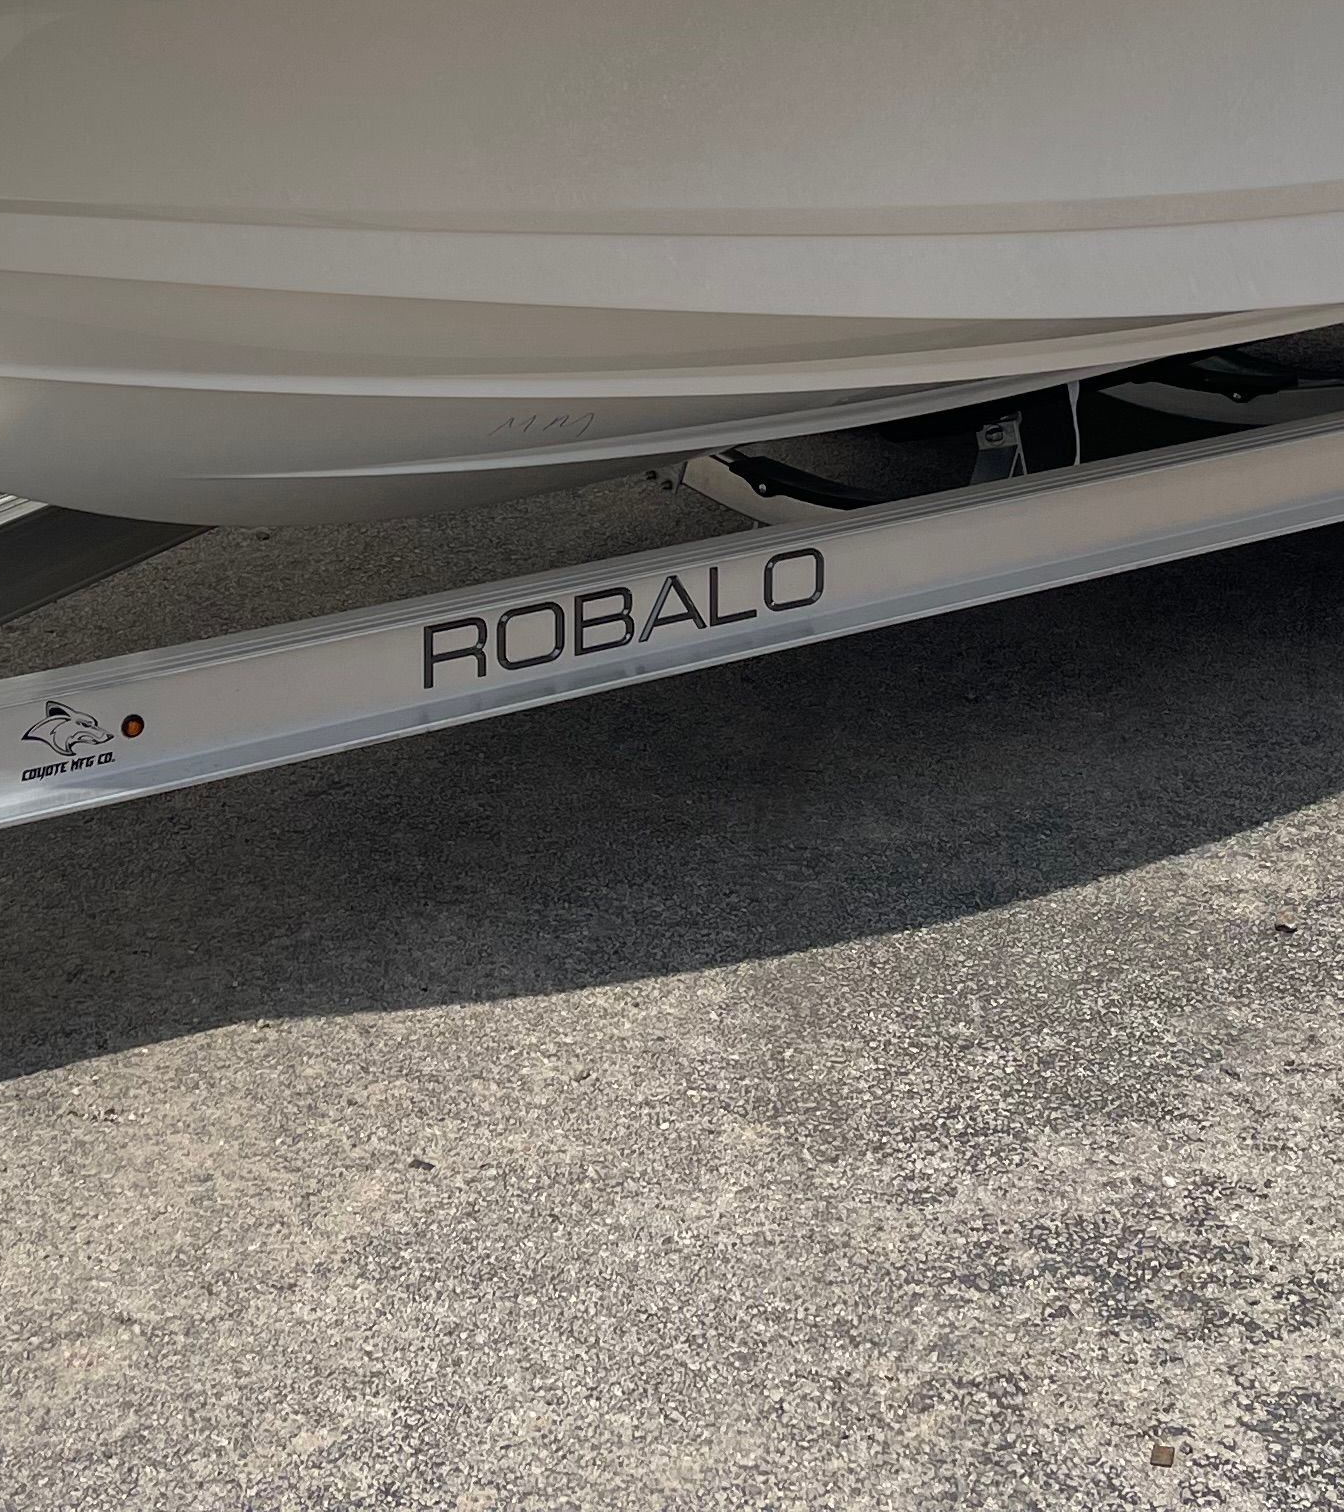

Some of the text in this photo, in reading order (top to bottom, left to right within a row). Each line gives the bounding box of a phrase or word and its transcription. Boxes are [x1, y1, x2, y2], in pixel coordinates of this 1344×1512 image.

[423, 547, 825, 690] ROBALO
[21, 751, 116, 782] COYOTE MFG CO.
